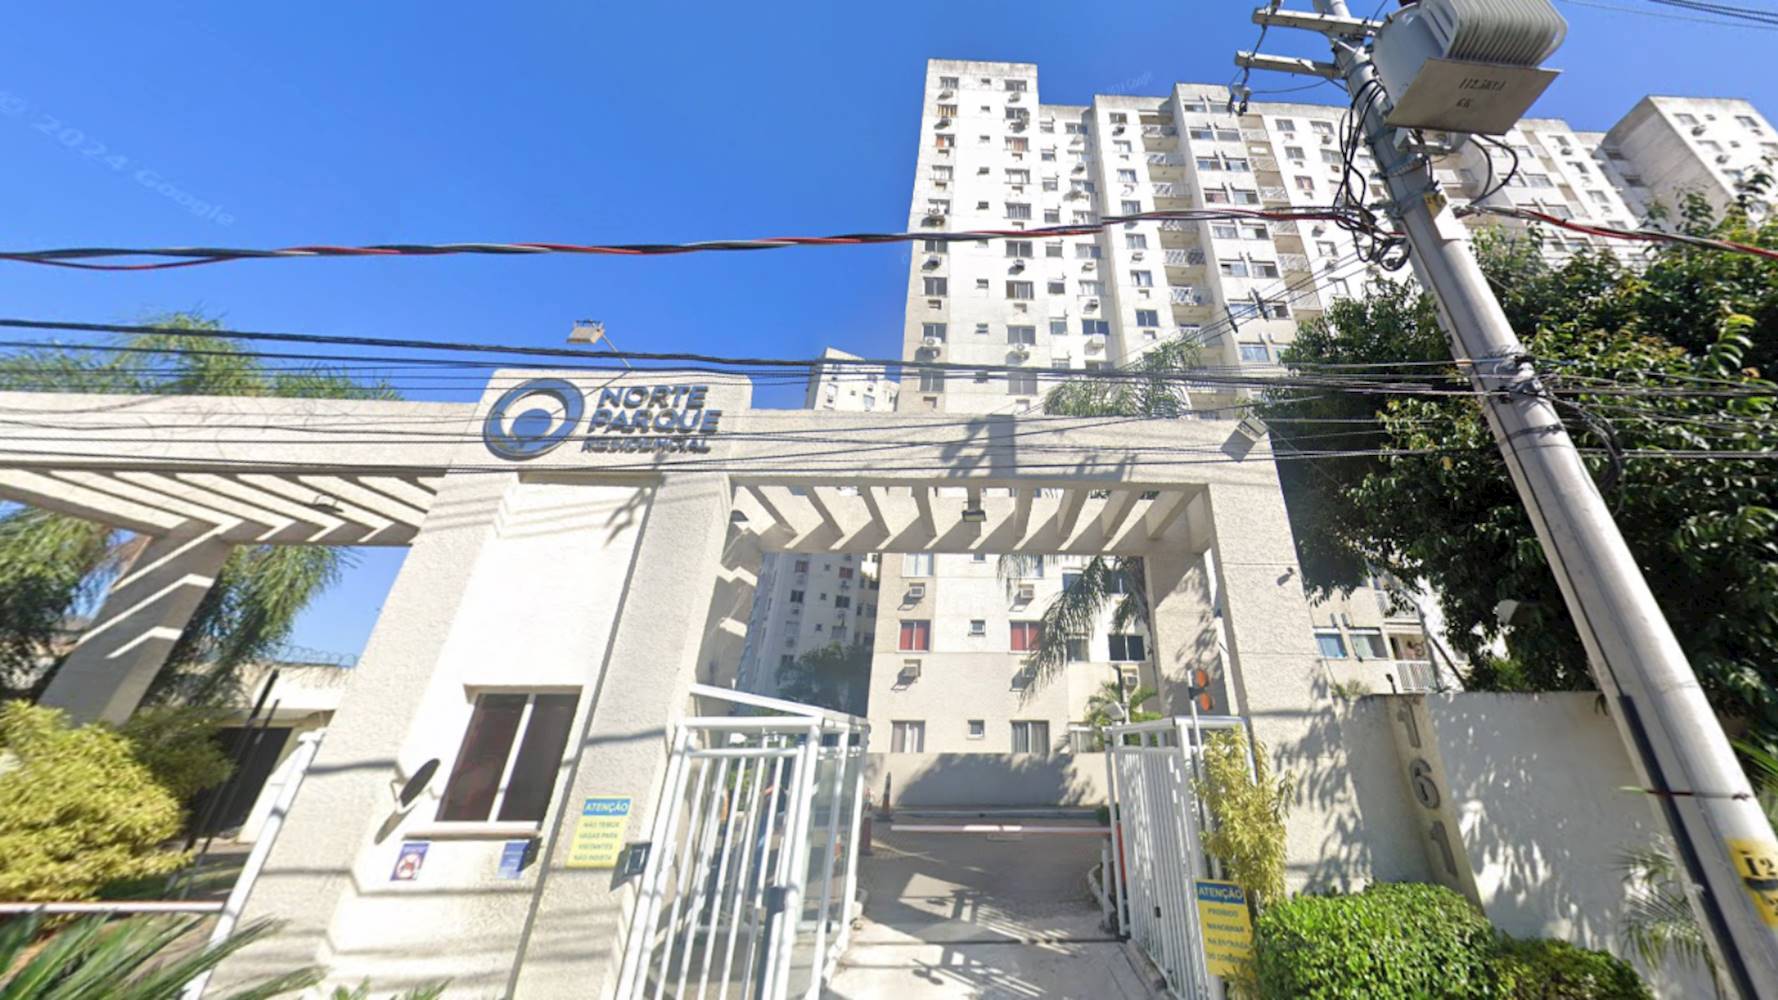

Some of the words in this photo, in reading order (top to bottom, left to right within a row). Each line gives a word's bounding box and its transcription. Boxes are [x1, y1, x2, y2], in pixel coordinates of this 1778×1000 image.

[598, 385, 708, 409] NORTE
[587, 408, 722, 434] PARQUE
[581, 437, 712, 454] RESIDENCIAL
[584, 801, 629, 813] ATENÇÃO
[1199, 886, 1243, 900] ATENÇÃO
